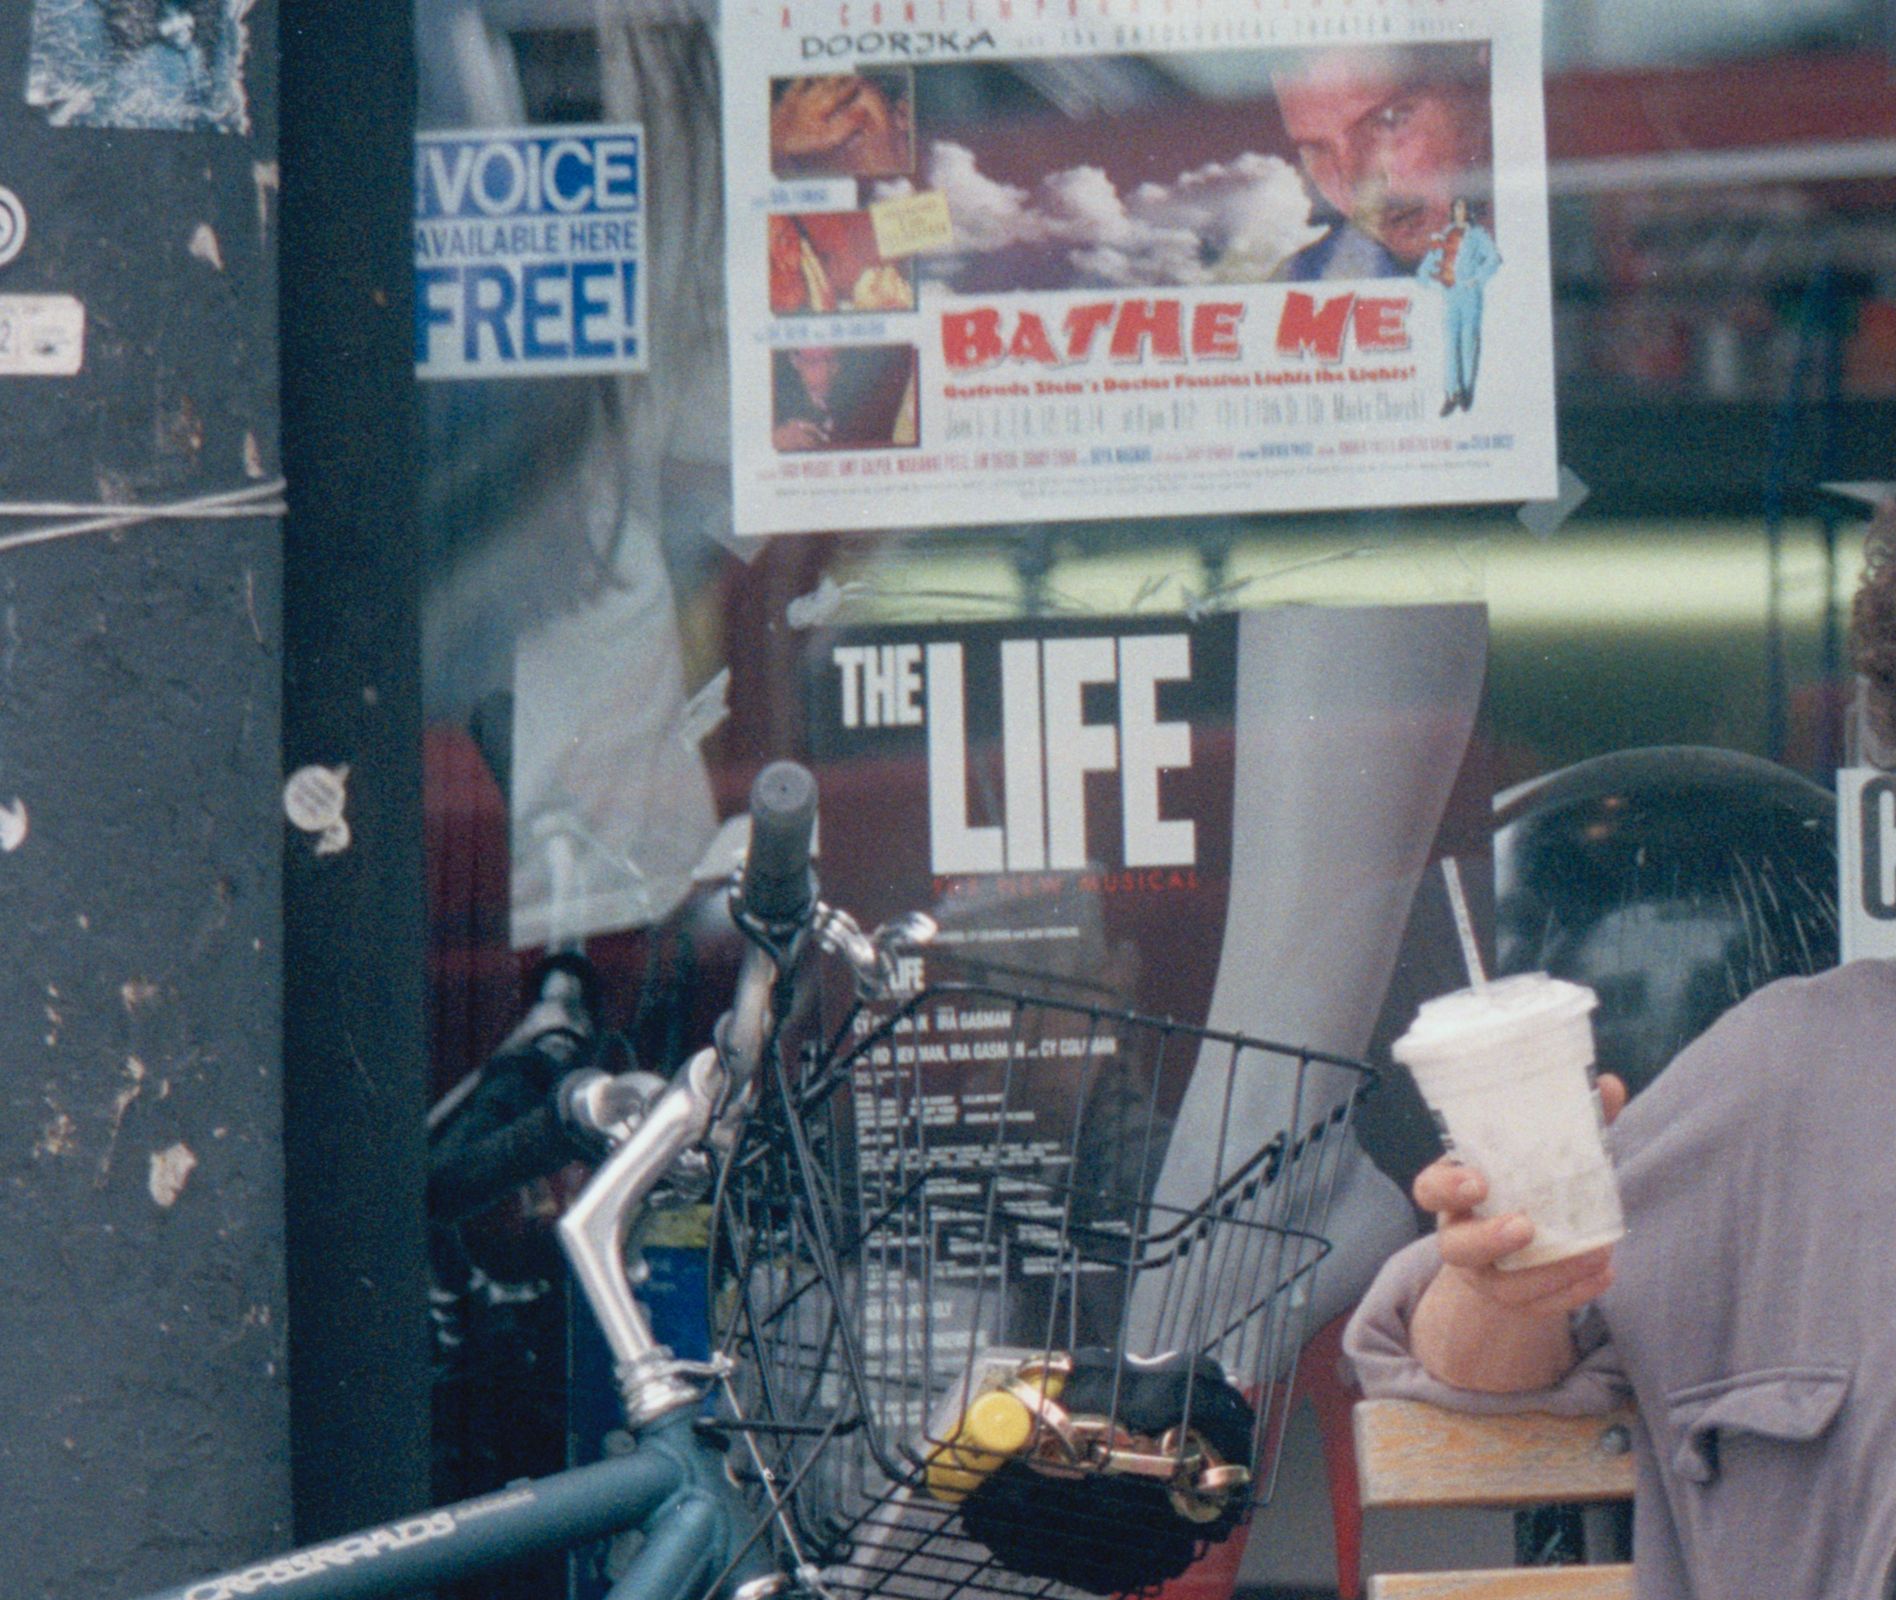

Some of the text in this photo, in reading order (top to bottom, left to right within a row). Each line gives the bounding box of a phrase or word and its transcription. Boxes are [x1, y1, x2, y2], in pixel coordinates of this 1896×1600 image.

[426, 140, 636, 216] VOICE
[416, 219, 638, 259] AVAILABLE HERE
[415, 259, 637, 364] FREE!
[941, 289, 1412, 372] BATHE ME
[833, 634, 1195, 874] THE LIFE
[1078, 868, 1199, 892] MUSICAL
